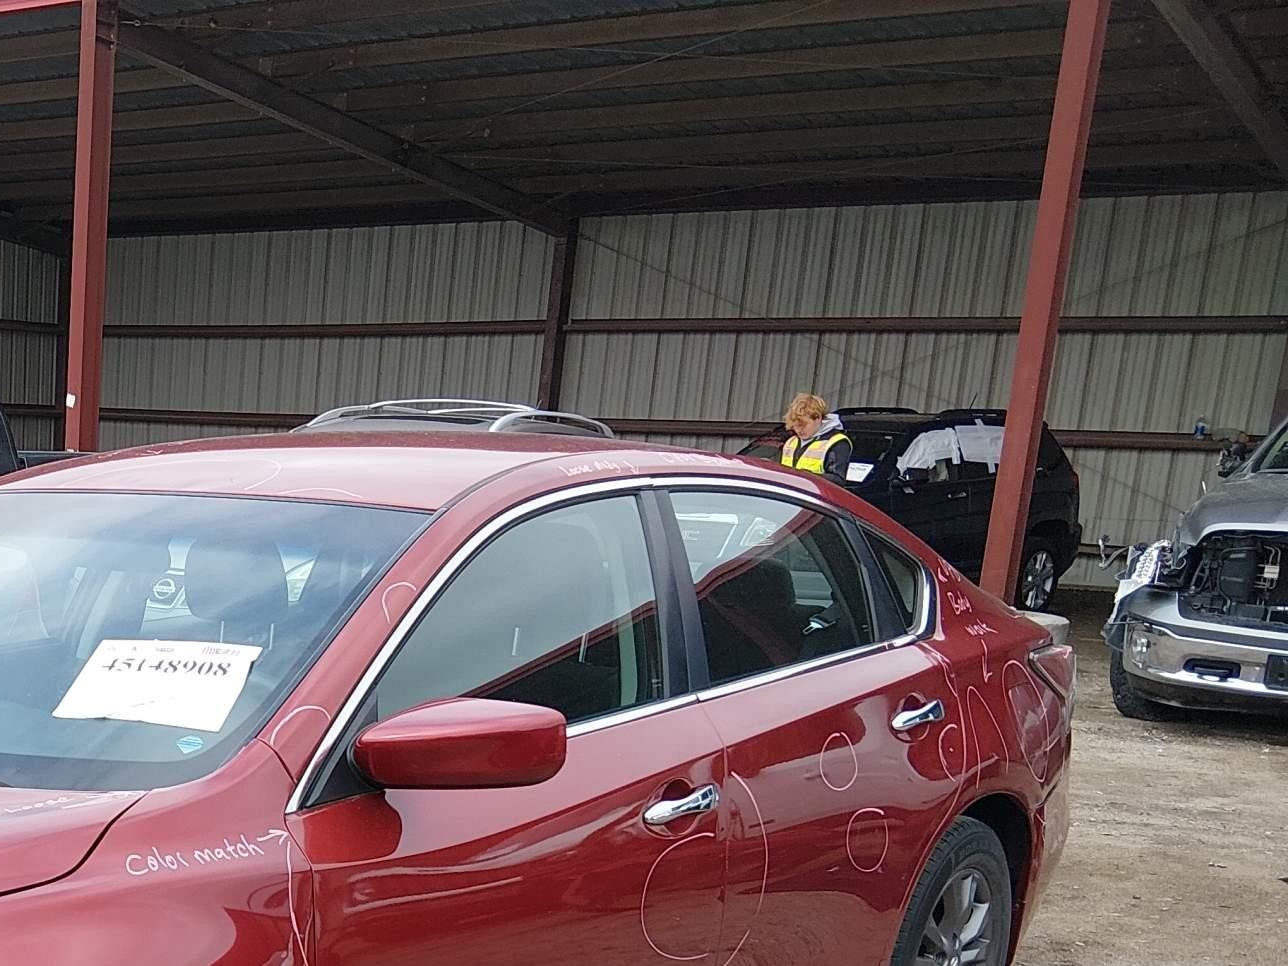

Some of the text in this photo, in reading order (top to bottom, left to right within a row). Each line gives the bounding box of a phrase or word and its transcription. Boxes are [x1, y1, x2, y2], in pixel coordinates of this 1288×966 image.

[102, 658, 231, 677] 45148908
[125, 834, 265, 877] Color match
